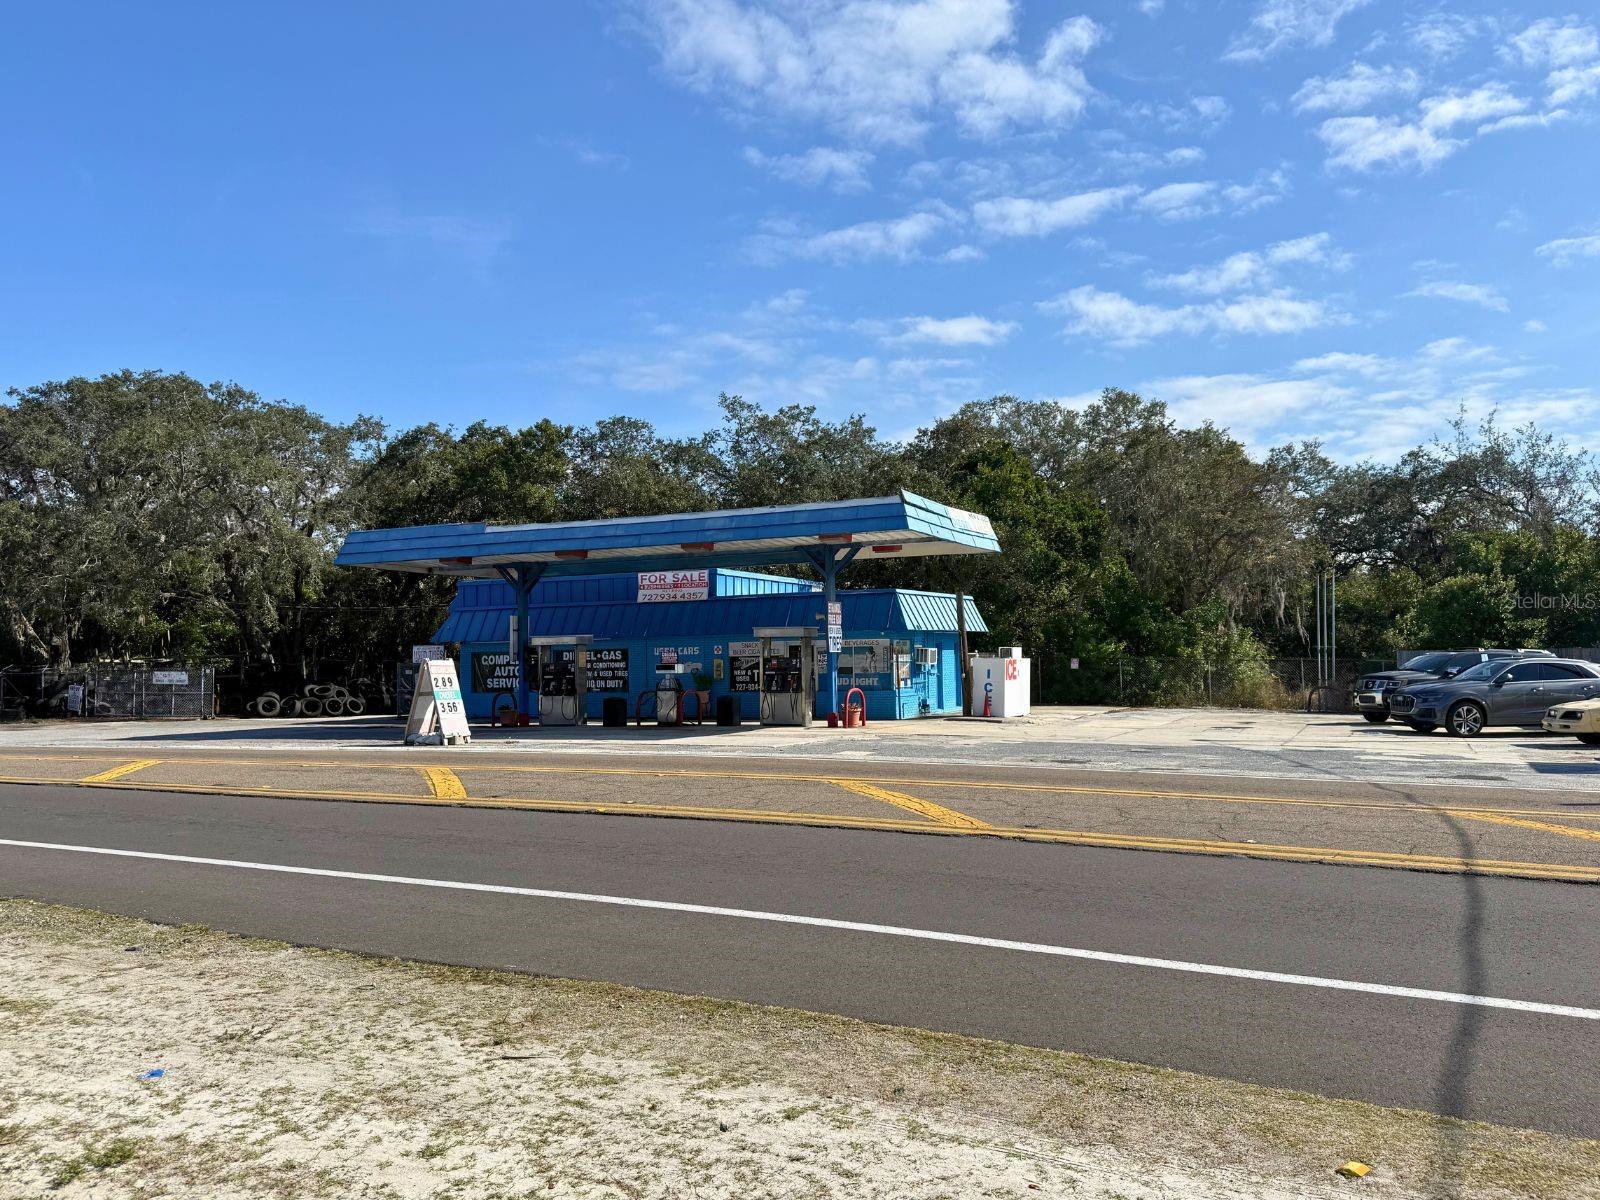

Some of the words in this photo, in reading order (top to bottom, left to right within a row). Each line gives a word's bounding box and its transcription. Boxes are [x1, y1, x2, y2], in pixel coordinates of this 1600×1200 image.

[640, 574, 667, 584] FOR
[672, 572, 706, 583] SALE
[642, 592, 704, 601] 727.934.4357
[601, 650, 622, 660] GAS
[678, 646, 700, 655] CARS
[1005, 659, 1018, 681] ICE
[595, 680, 606, 688] ON
[606, 680, 624, 688] DUTY
